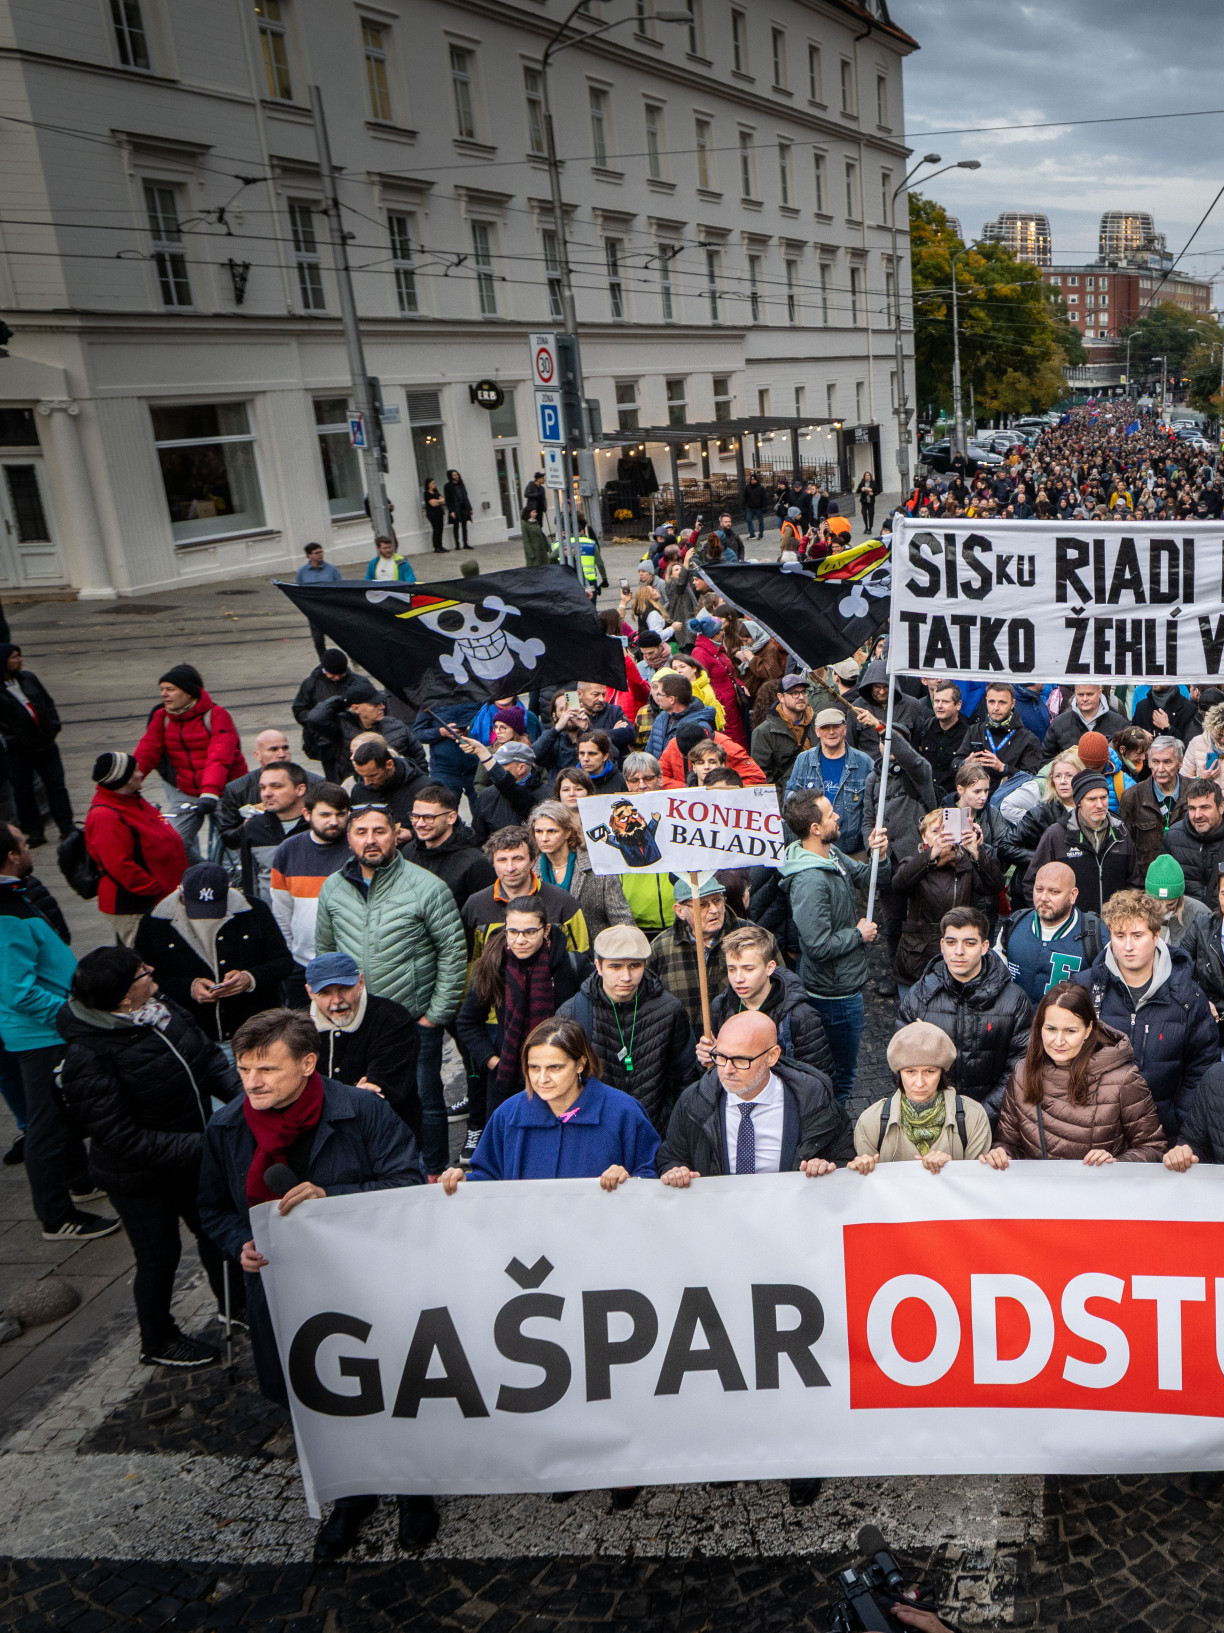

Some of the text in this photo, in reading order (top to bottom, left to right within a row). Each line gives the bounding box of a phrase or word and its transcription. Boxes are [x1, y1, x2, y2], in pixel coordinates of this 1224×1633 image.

[539, 356, 551, 374] 30
[477, 390, 498, 400] ERB
[544, 409, 555, 436] P
[1055, 536, 1195, 605] RIADI
[899, 610, 1036, 674] TATKO
[1065, 605, 1179, 676] ŽEHLÍ
[665, 797, 782, 835] KONIEC
[669, 823, 786, 861] BALADY
[1044, 952, 1082, 996] F
[288, 1255, 832, 1420] GAŠPAR
